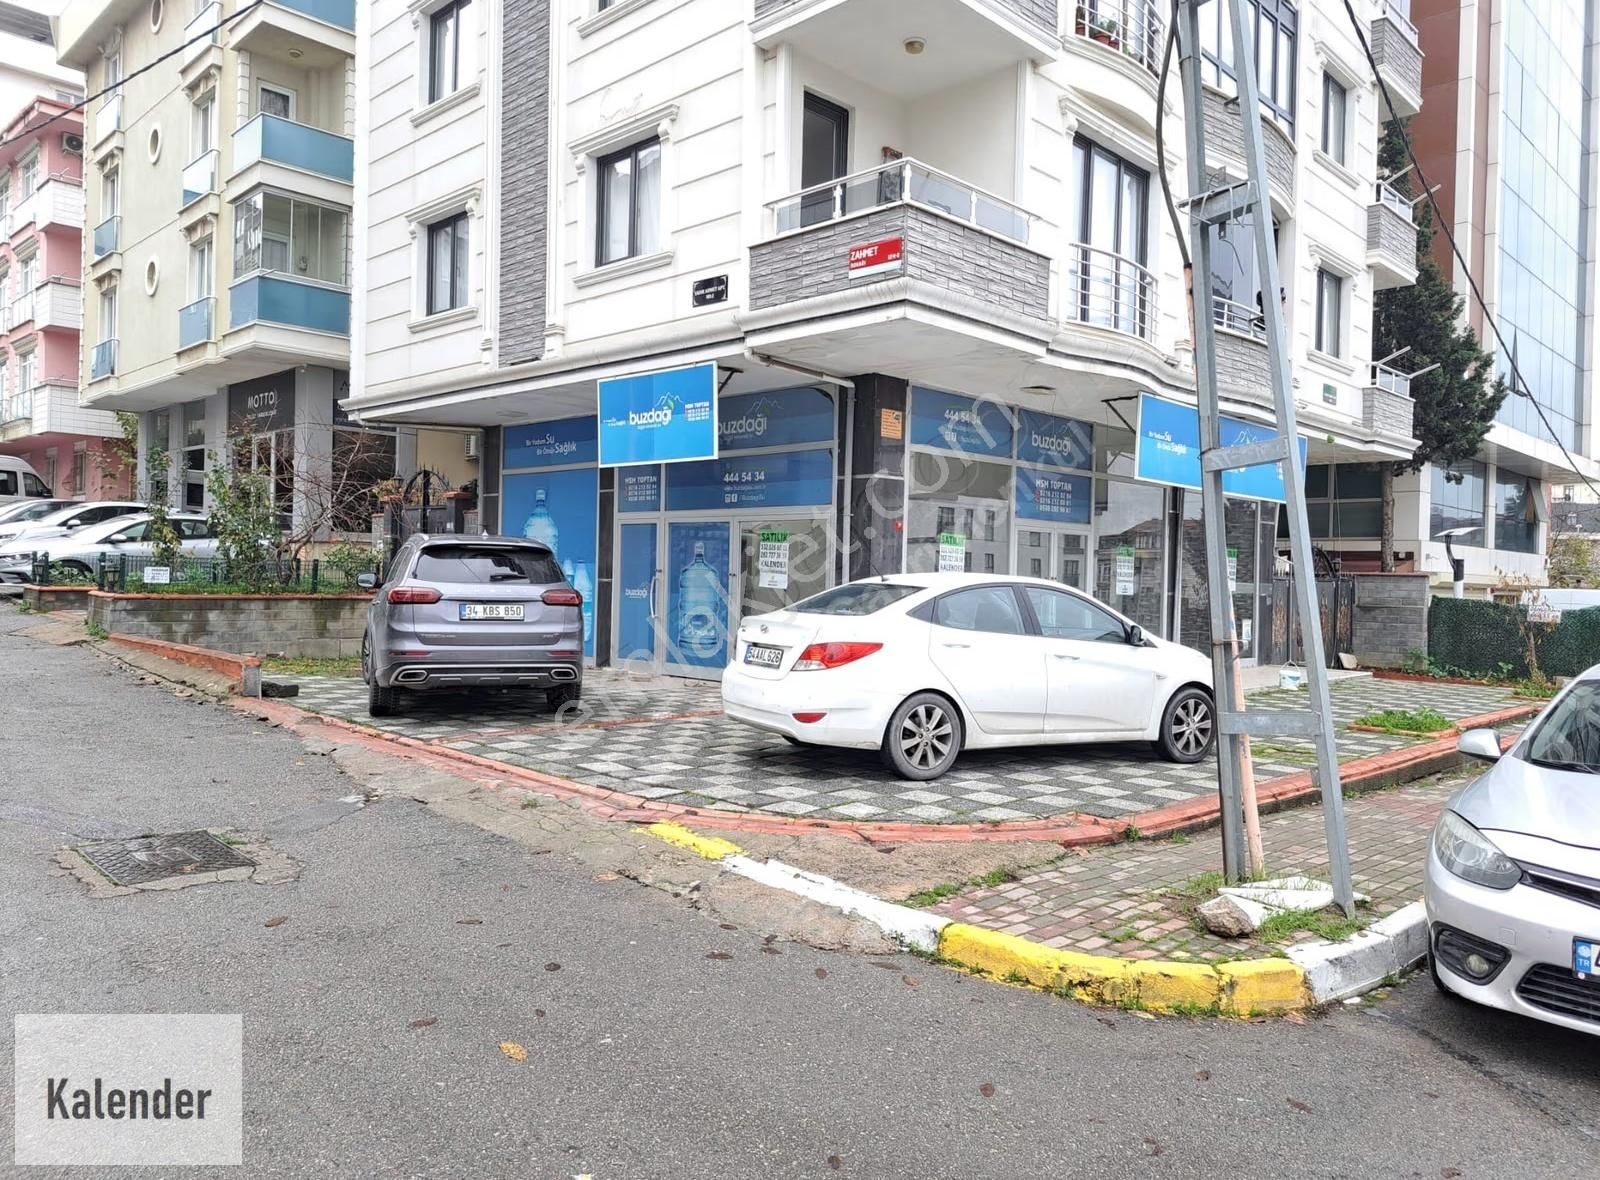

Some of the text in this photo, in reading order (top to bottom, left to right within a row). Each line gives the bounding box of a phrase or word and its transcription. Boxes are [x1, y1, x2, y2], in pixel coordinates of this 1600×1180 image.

[850, 245, 879, 261] ZAHMET
[247, 391, 275, 408] MOTTO
[629, 406, 672, 426] buzdağı
[546, 433, 555, 444] Su
[554, 441, 577, 456] Sağlık
[724, 471, 765, 483] 444 54 34
[1035, 479, 1072, 490] MSM TOPTAN
[466, 605, 522, 616] 34 KBS 850
[1577, 958, 1590, 967] TR
